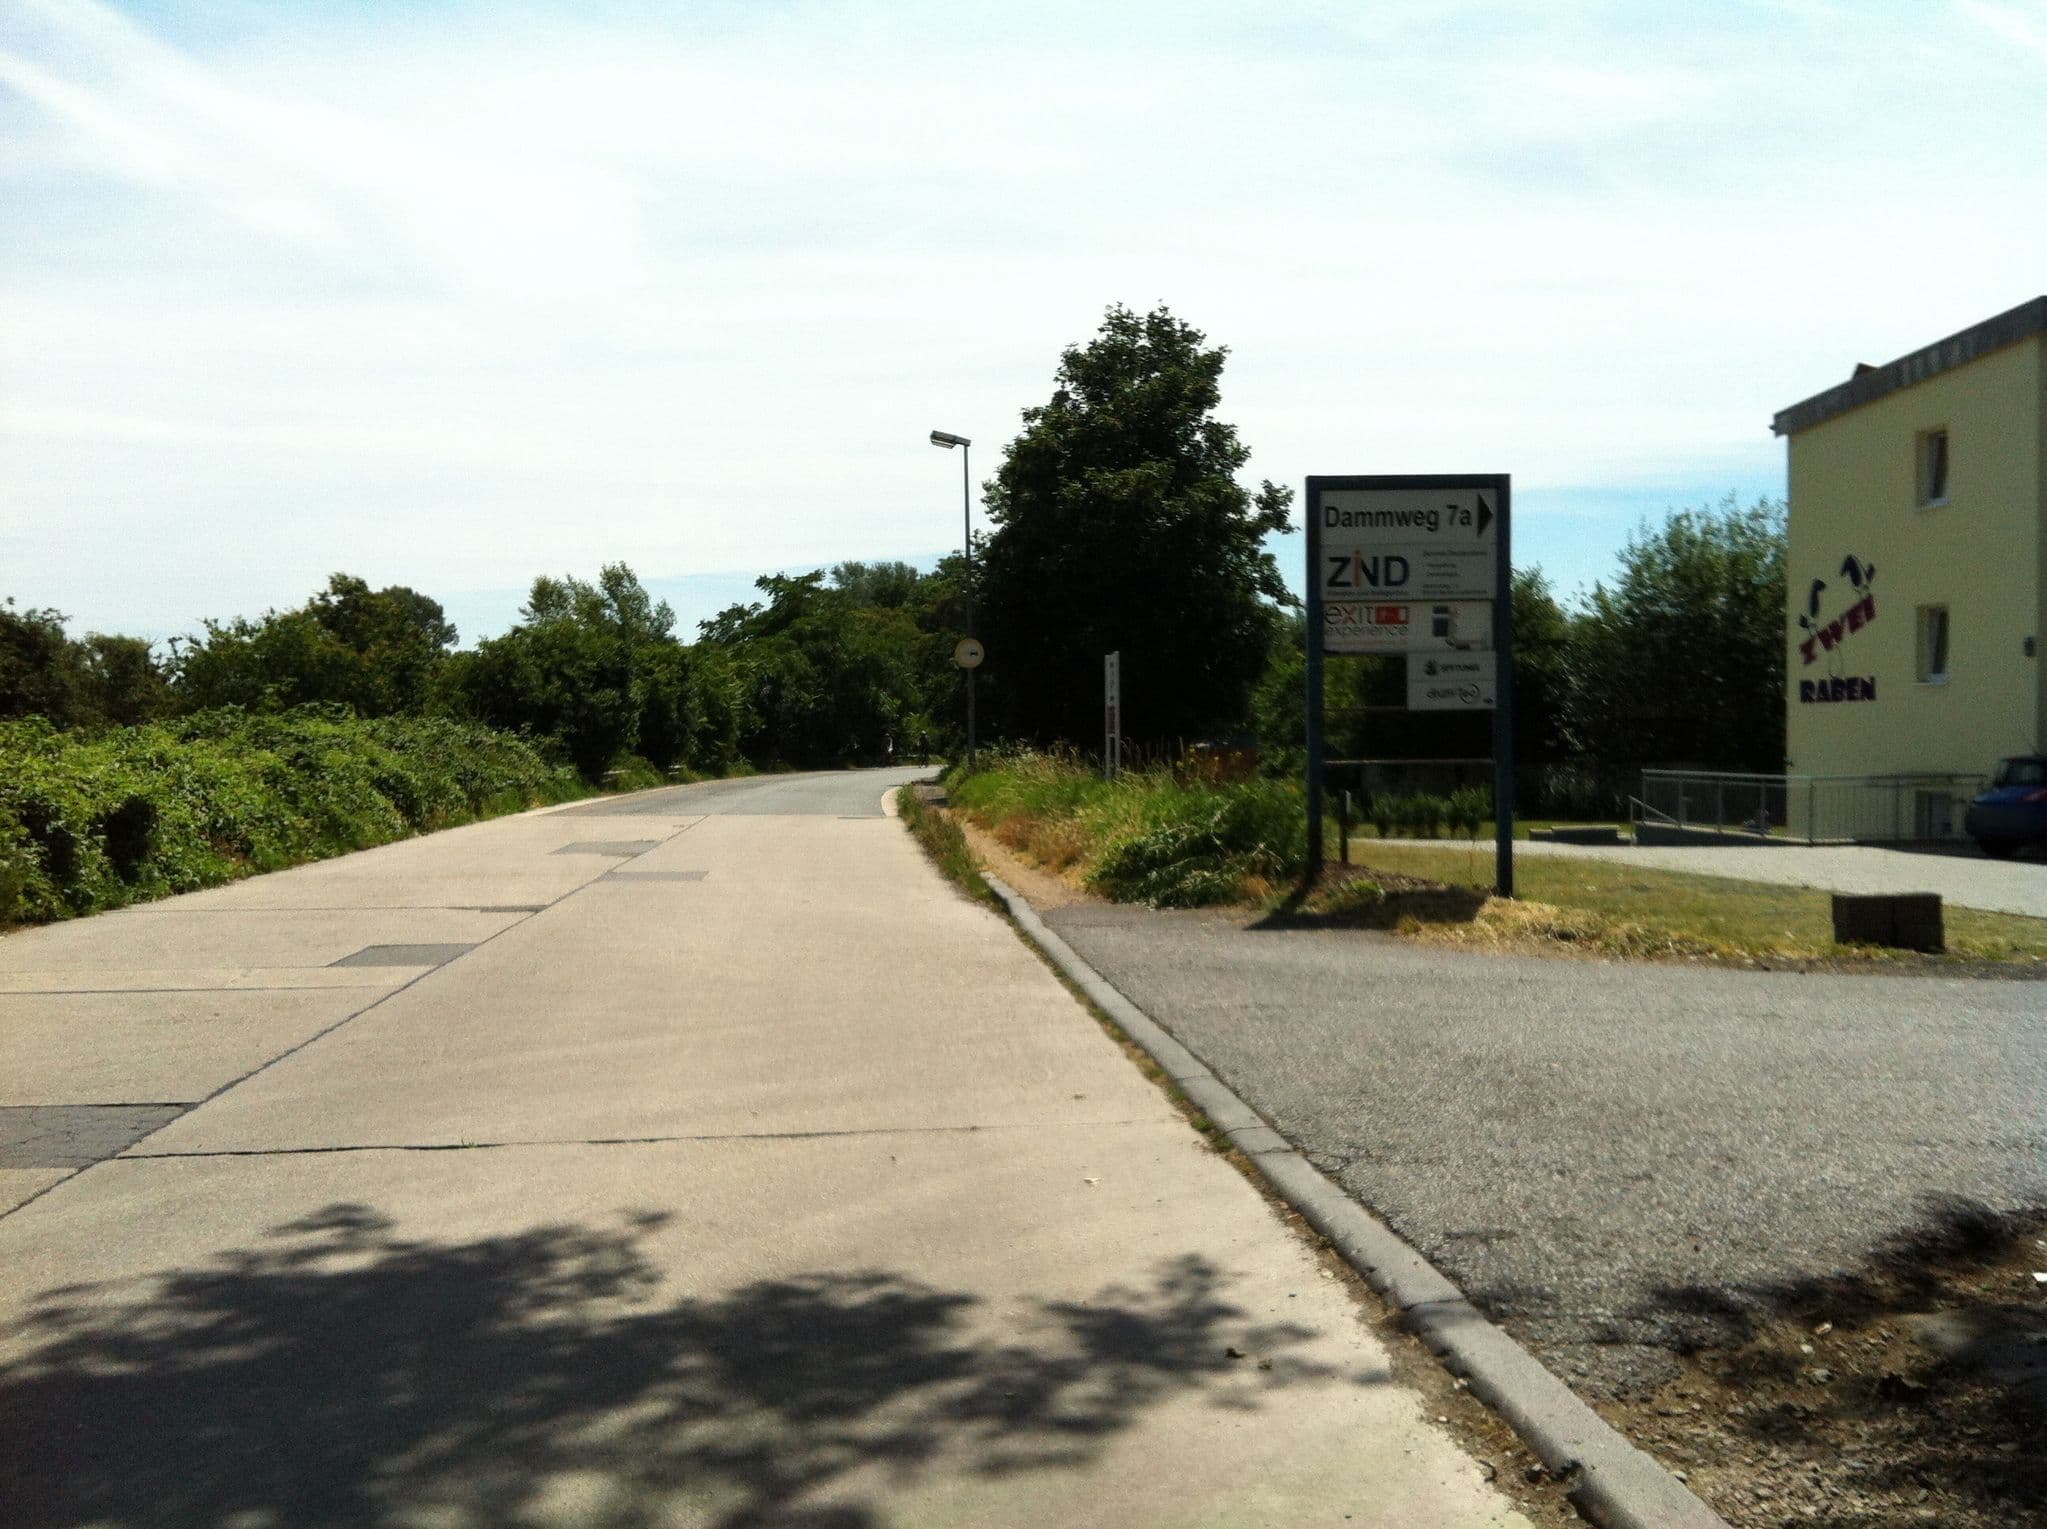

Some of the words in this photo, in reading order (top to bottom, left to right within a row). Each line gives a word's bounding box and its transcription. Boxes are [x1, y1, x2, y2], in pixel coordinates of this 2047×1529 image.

[1325, 506, 1439, 532] Dammweg
[1446, 504, 1473, 526] 7a
[1800, 677, 1876, 702] RABEN
